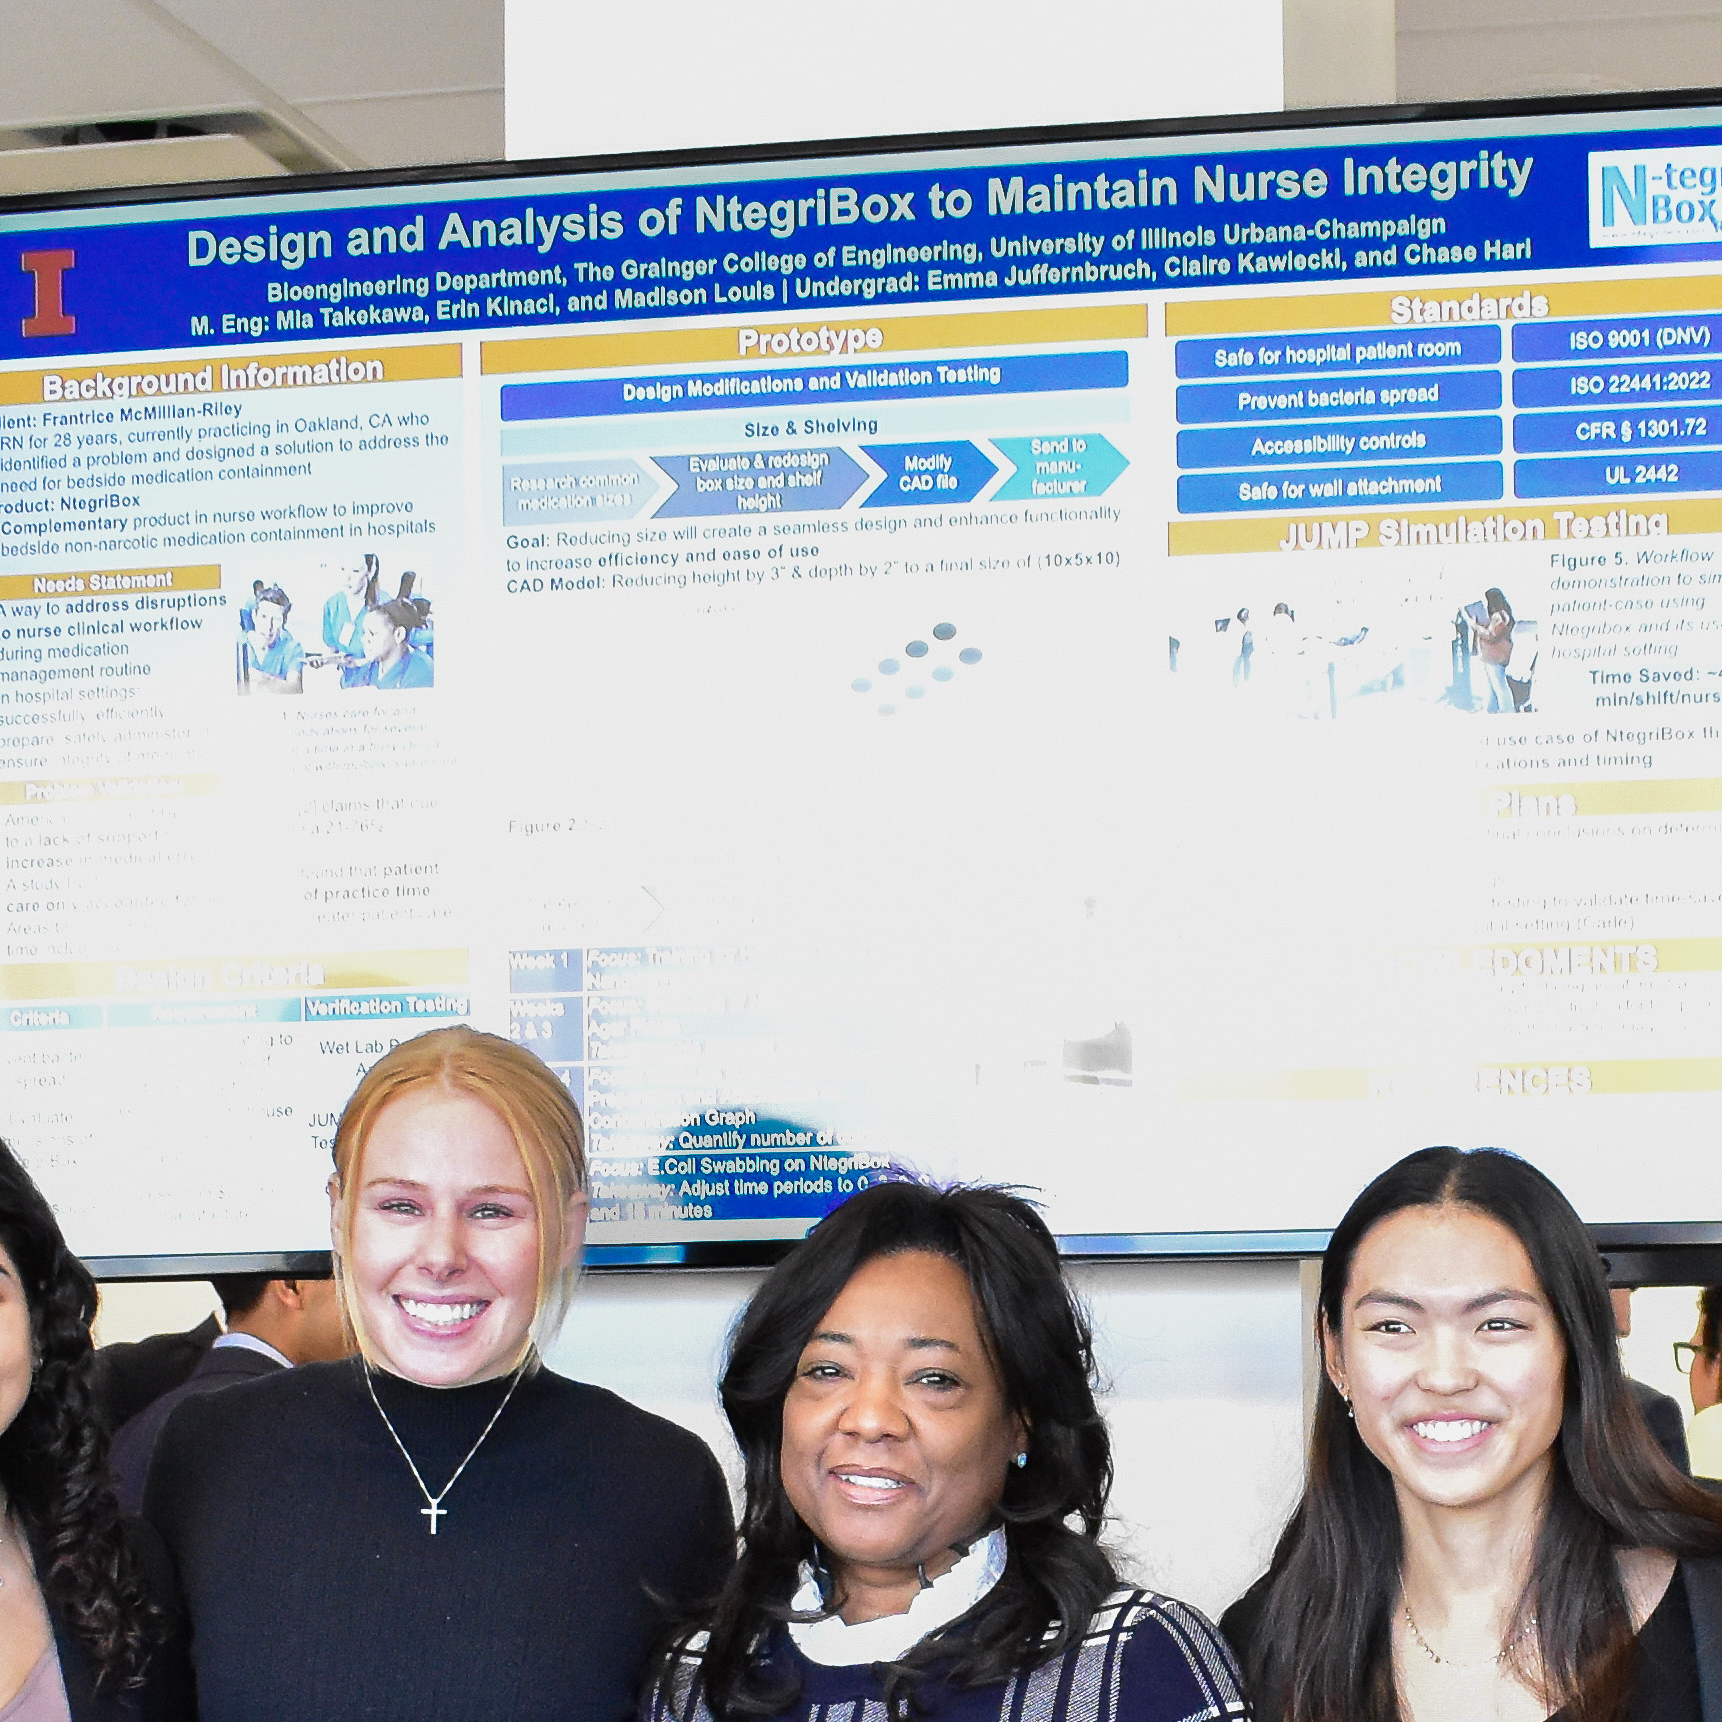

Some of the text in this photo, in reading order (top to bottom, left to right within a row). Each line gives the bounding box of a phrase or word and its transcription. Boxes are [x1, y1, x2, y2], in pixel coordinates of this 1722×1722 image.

[188, 151, 1533, 270] Design and Analysis of NtegriBox to Maintain Nurse Integrity
[268, 214, 1446, 303] Bioengineering Department, The Grainger College of Engineering, University of Illinois Urbana-Champaign
[191, 242, 1477, 336] M. Eng: Mia Takekawa, Erin Kinaci, and Madison Louis Undergrad: Emma Juffernbruch, Claire Kawiecki, and Chase
[1391, 291, 1549, 325] Standards
[738, 326, 882, 356] Prototype
[1571, 326, 1711, 350] ISO 9001 (DNV)
[1214, 340, 1461, 368] Safe for hospital patient room
[43, 357, 383, 401] Background Information
[623, 365, 1001, 403] Design Modifications Validation Testing
[1571, 371, 1711, 395] ISO 22441:2022
[1239, 385, 1439, 411] Prevent bacteria spread
[43, 410, 114, 427] Frantrice
[745, 419, 878, 437] Size Shelving
[1576, 418, 1707, 440] CFR 1301.72
[77, 416, 363, 450] years, currently practicing Oakland,
[1252, 431, 1426, 456] Accessibility controls
[0, 435, 419, 472] identified problem designed solution address
[689, 450, 829, 473] Evaluate redesign
[0, 462, 311, 493] need bedside medication containment
[726, 469, 822, 490] size shelf
[1635, 464, 1679, 483] 2442
[1032, 480, 1086, 495] facturer
[1239, 476, 1441, 501] Safe for wall attachment
[61, 494, 140, 513] NtegriBox
[737, 493, 782, 512] height
[1, 501, 413, 536] Complementary product nurse workflow improve
[557, 506, 1120, 547] Reducing seamless functionality
[1, 520, 436, 557] bedside non-narcotic medication containment hospitals
[1280, 510, 1669, 552] JUMP Simulation Testing
[527, 552, 678, 571] increase efficiency
[612, 551, 1120, 590] Reducing depth (10x5x10)
[34, 571, 173, 594] Needs Statement
[66, 594, 227, 614] address disruptions
[17, 617, 202, 638] nurse clinical workflow
[48, 642, 129, 659] medication
[100, 663, 151, 678] routine
[15, 688, 73, 705] hospital
[307, 996, 468, 1016] Verification Testing
[320, 1040, 383, 1054] Wet Lab
[679, 1133, 746, 1150] Quantify
[701, 1152, 890, 1176] Swabbing NtegriBox
